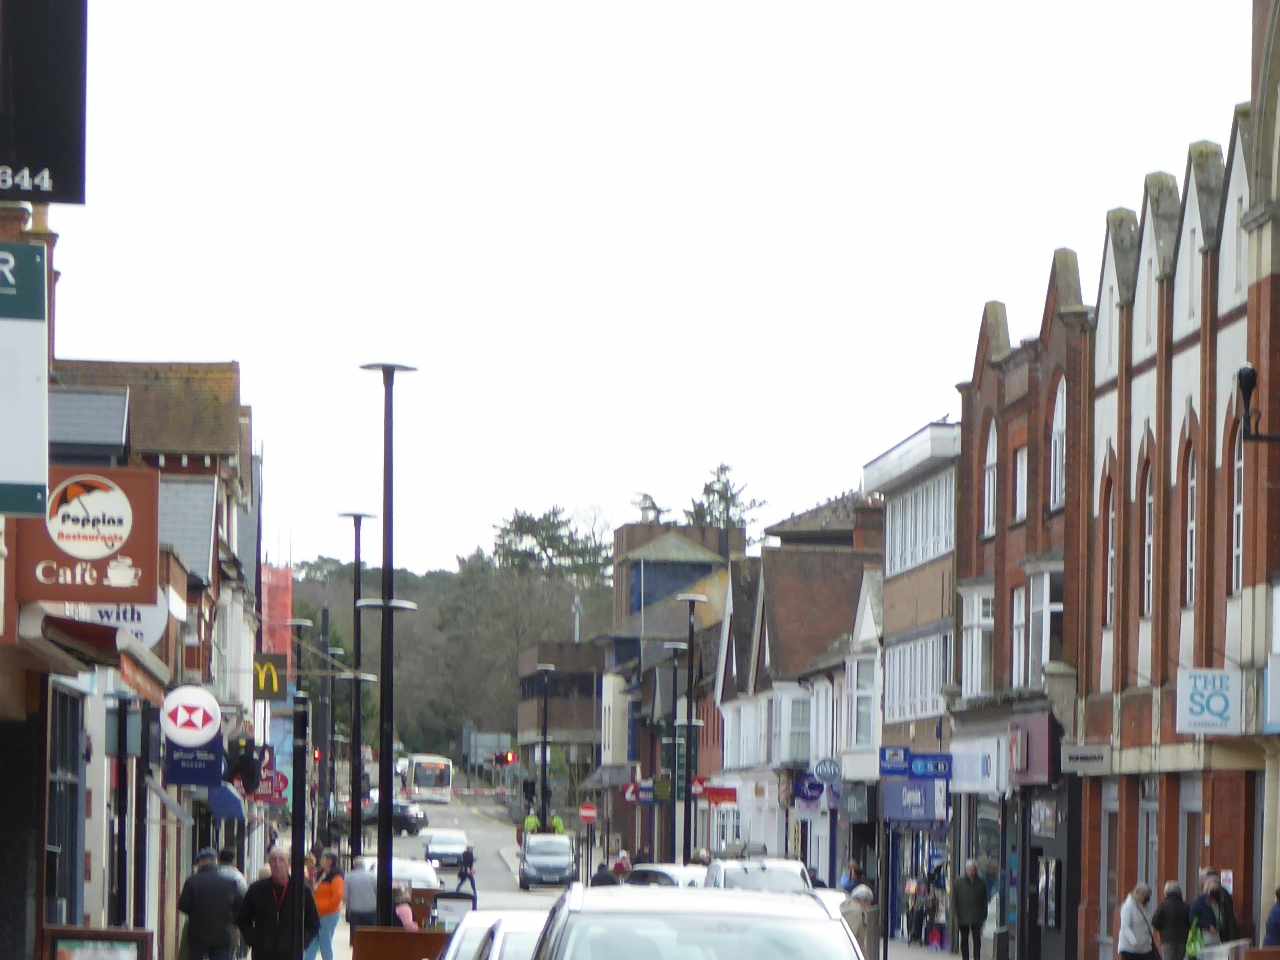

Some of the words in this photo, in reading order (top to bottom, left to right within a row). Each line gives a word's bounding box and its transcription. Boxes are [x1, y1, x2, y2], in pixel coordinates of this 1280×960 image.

[61, 511, 124, 529] Poppins
[1188, 674, 1230, 690] THE
[1188, 691, 1231, 721] SQ
